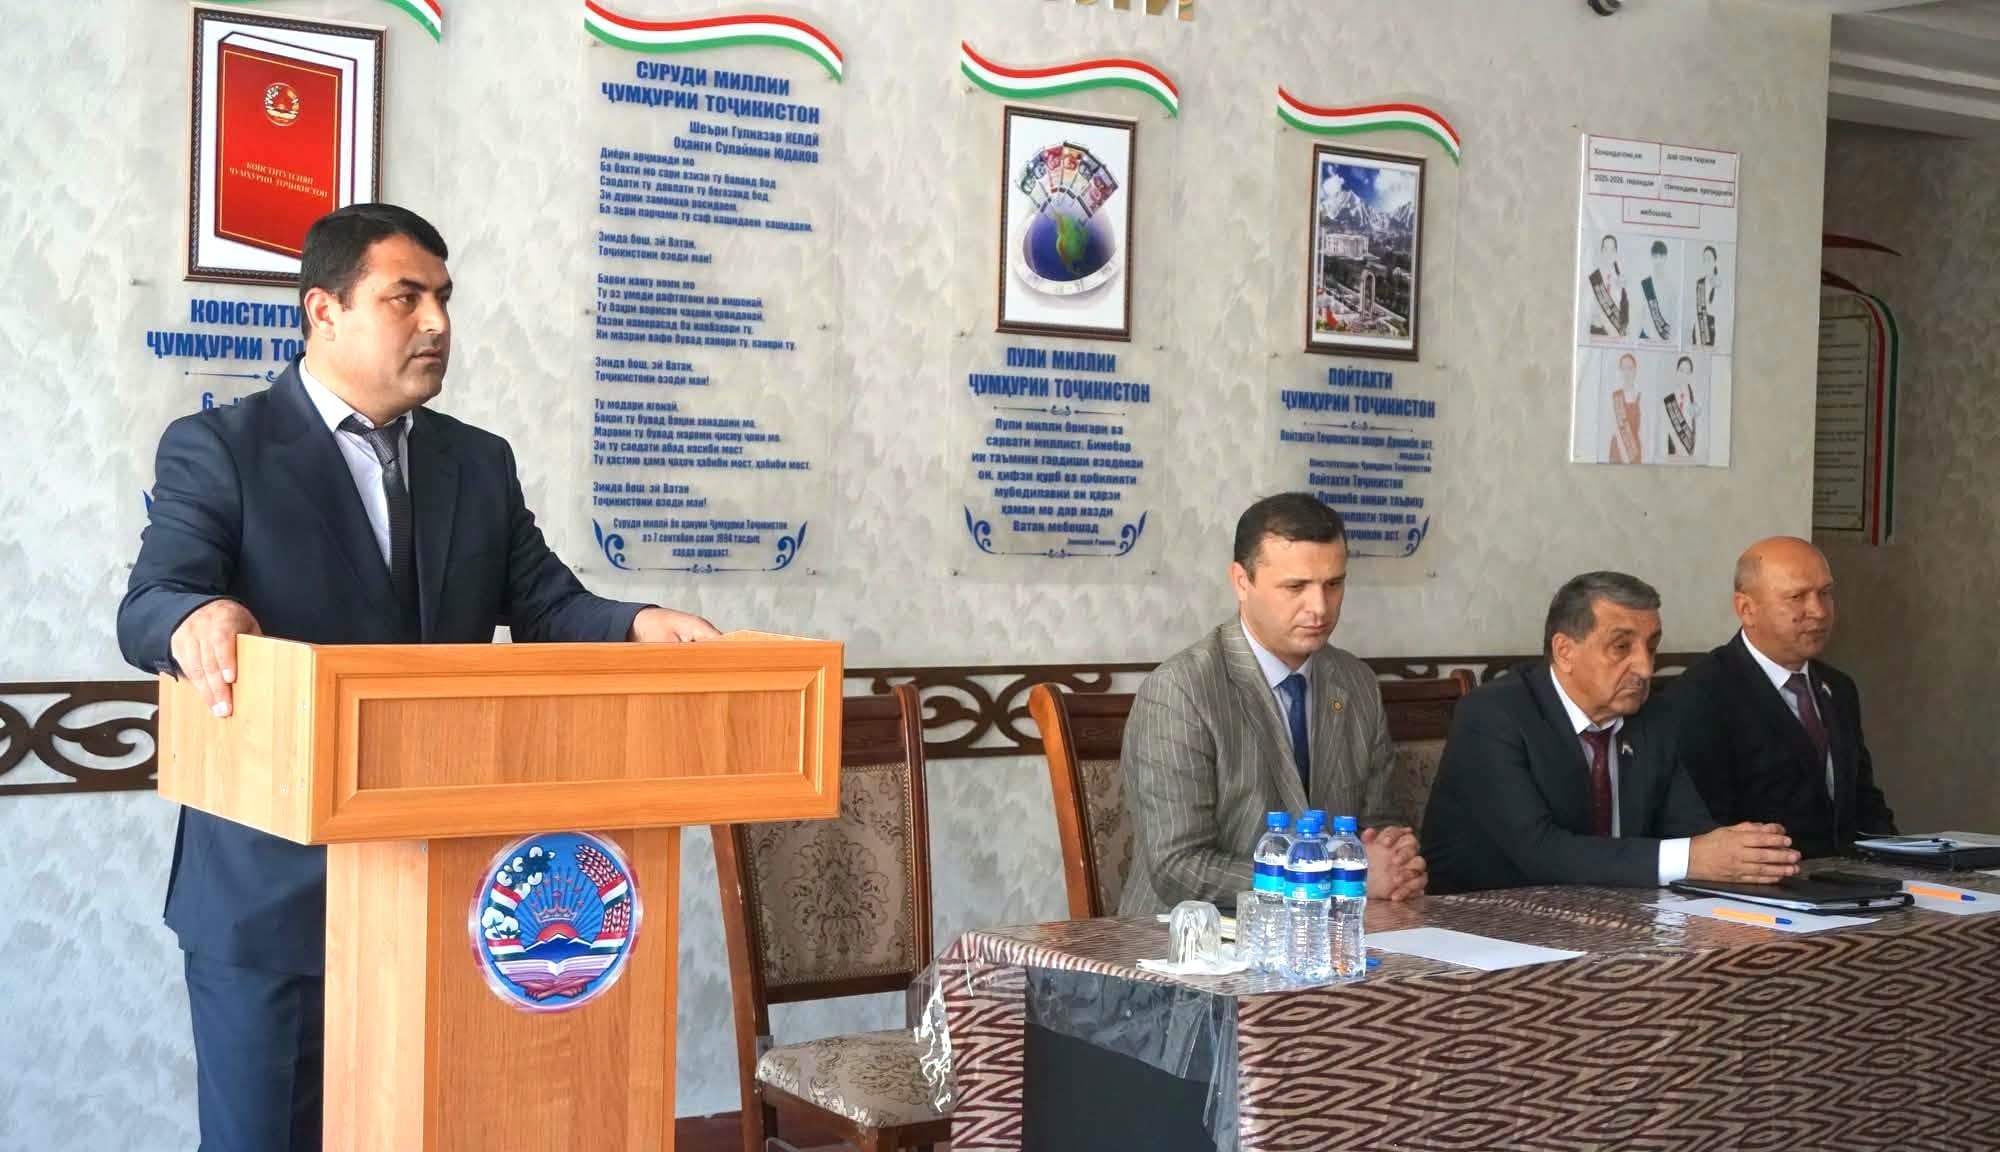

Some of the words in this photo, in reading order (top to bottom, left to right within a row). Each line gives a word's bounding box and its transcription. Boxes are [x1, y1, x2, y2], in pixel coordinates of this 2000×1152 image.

[636, 60, 707, 87] СУРУДИ
[714, 70, 789, 96] МИЛЛИИ
[602, 82, 698, 110] ҶУМҲУРИИ
[705, 94, 819, 124] ТОҶИКИСТОН
[689, 121, 728, 136] Шеъри
[715, 140, 770, 158] Сулаймон
[774, 147, 818, 164] ЮДАКОВ
[713, 174, 722, 184] ту
[642, 181, 651, 190] ту
[697, 186, 706, 196] ту
[682, 212, 690, 222] ту
[191, 299, 301, 328] КОНСТИТУ
[147, 331, 262, 360] ҶУМҲУРИИ
[1007, 347, 1046, 368] ПУЛИ
[1052, 351, 1116, 373] МИЛЛИИ
[1328, 365, 1393, 389] ПОЙТАХТИ
[969, 374, 1049, 399] ҶУМҲУРИИ
[1055, 378, 1150, 402] ТОҶИКИСТОН
[595, 398, 604, 410] Ту
[1282, 390, 1350, 414] ҶУМҲУРИИ
[1354, 395, 1436, 418] ТОҶИКИСТОН
[626, 415, 634, 424] ту
[996, 418, 1022, 433] Пули
[1111, 425, 1123, 435] ва
[635, 429, 643, 438] ту
[609, 442, 618, 452] ту
[594, 454, 603, 466] Ту
[1065, 474, 1076, 484] ва
